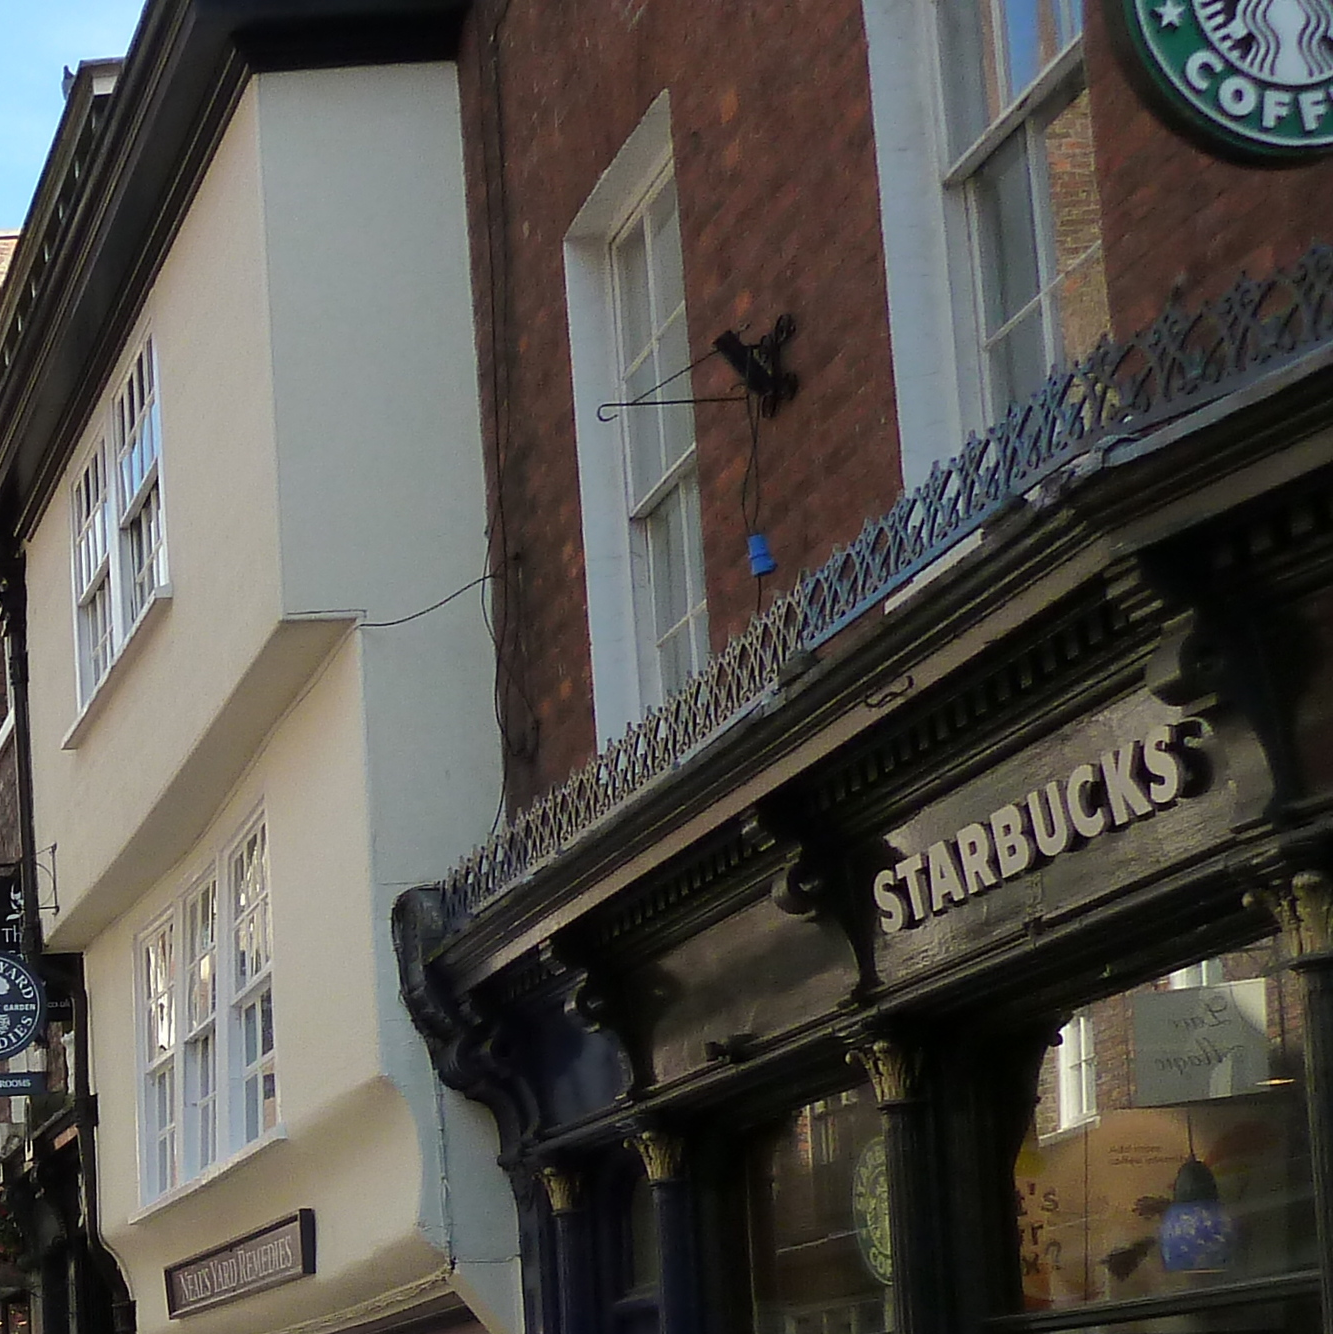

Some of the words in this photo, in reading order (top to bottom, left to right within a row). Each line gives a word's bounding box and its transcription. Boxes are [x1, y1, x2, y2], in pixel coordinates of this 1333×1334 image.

[1184, 50, 1333, 134] COFF
[873, 725, 1178, 934] STARBUCKS
[3, 1003, 36, 1012] GARDEN
[0, 1078, 32, 1088] ROOMS
